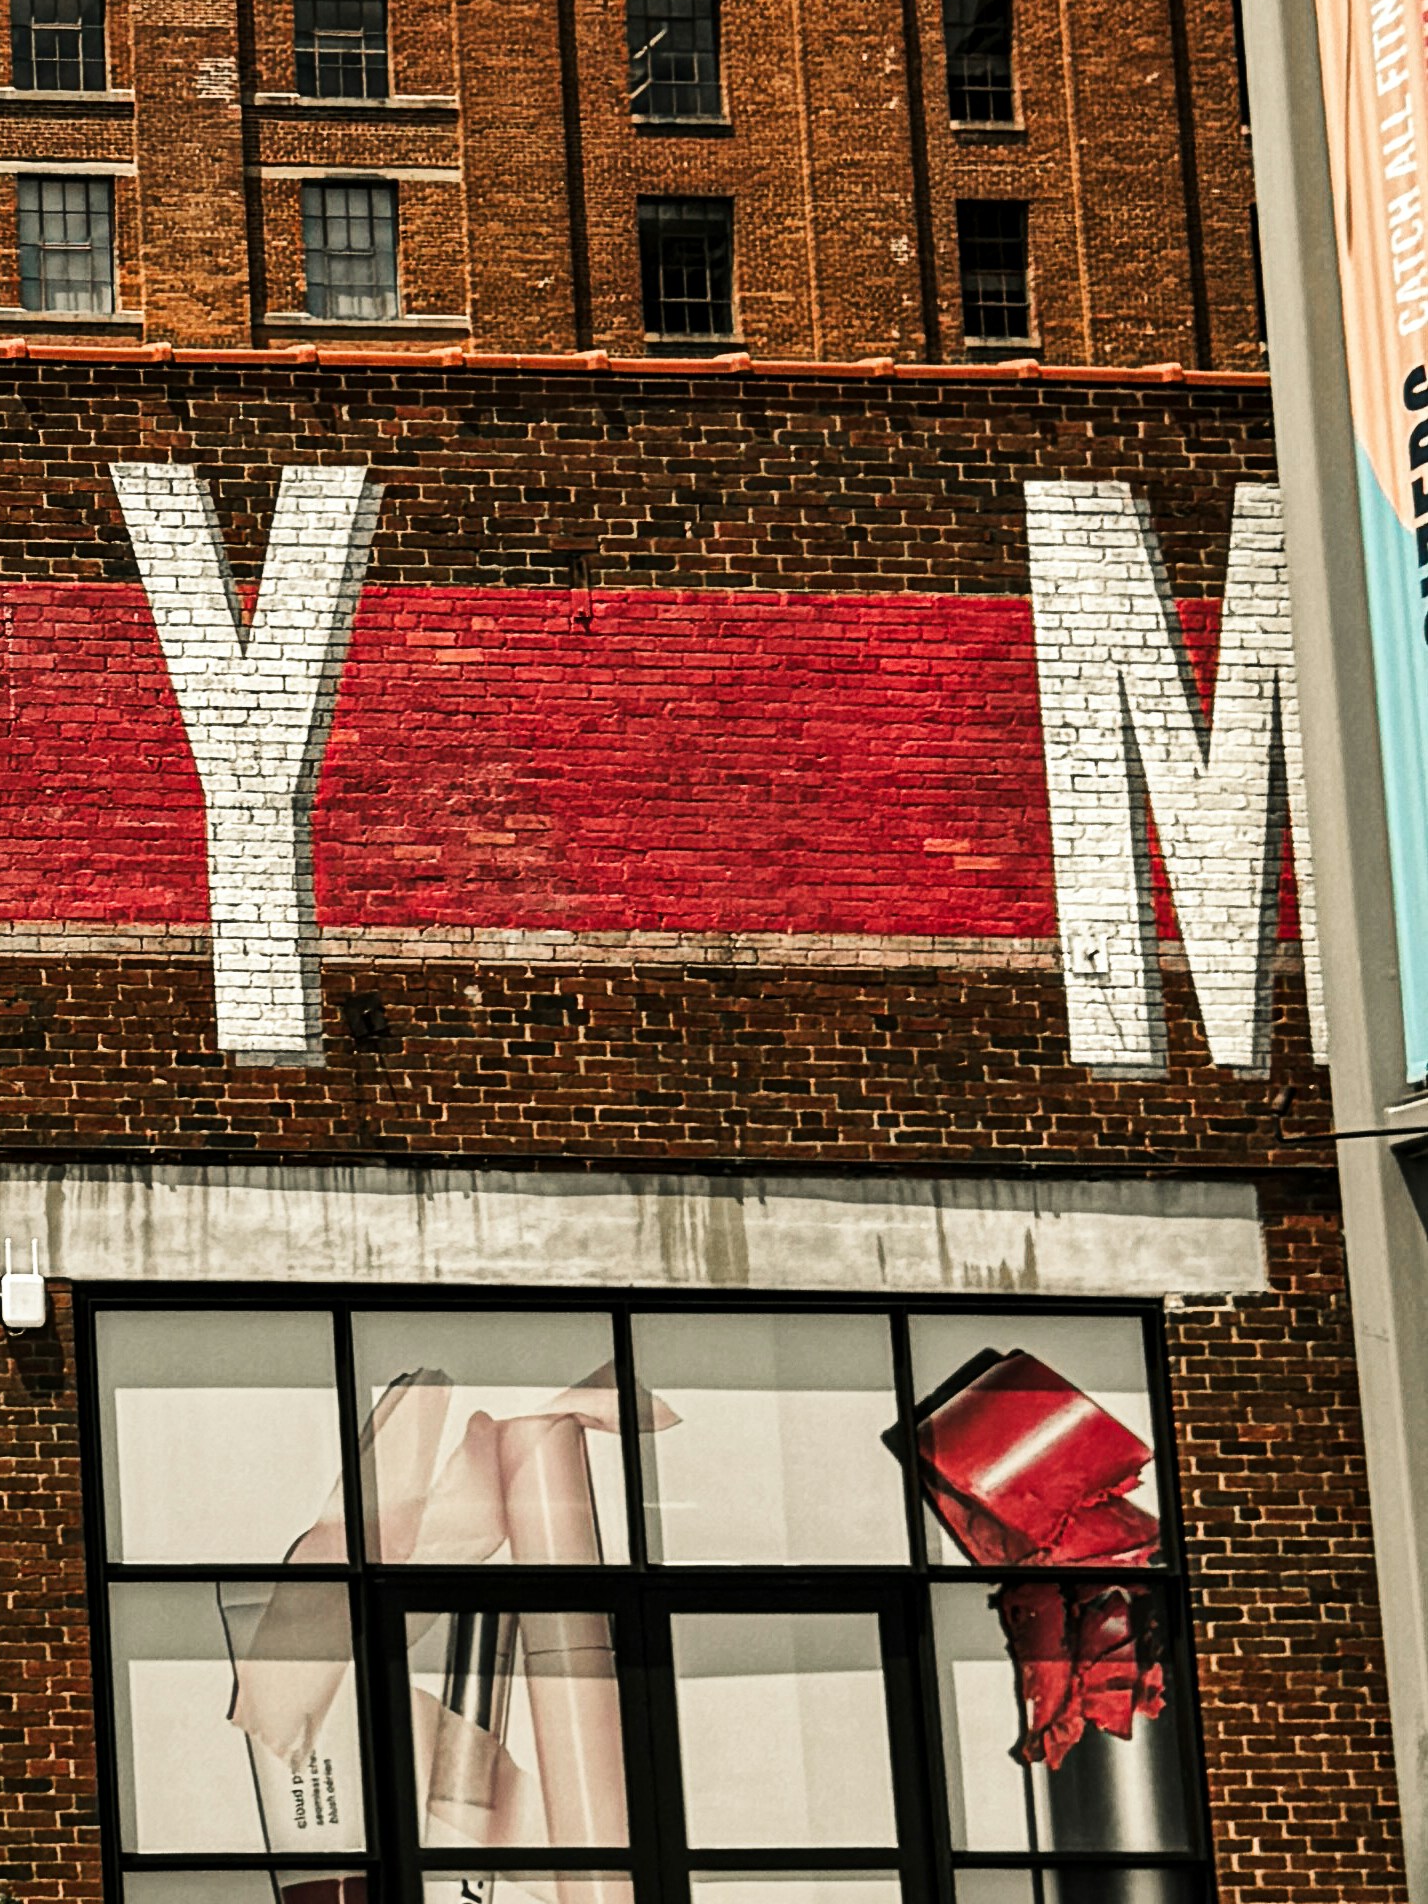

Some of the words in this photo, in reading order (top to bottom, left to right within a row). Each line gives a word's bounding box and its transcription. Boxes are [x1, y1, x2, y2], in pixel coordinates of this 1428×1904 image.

[1380, 92, 1419, 181] ALL
[1389, 189, 1427, 337] CATCH
[291, 1789, 307, 1829] cloud
